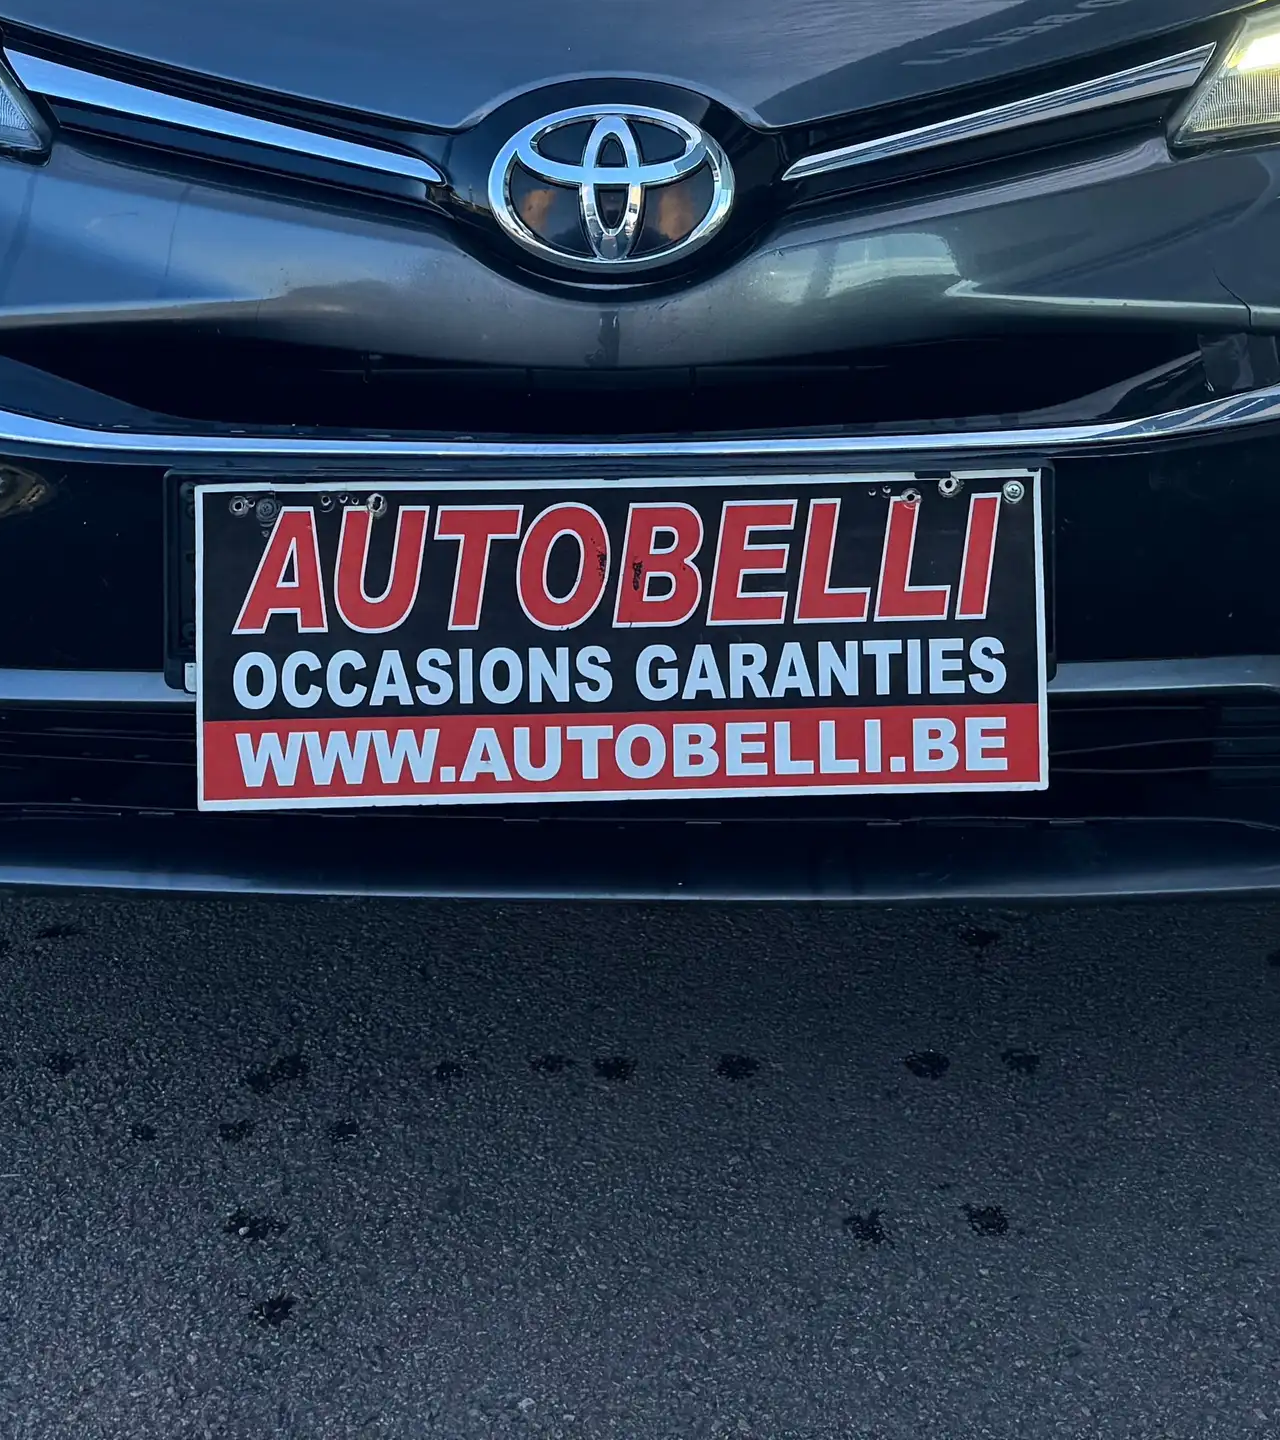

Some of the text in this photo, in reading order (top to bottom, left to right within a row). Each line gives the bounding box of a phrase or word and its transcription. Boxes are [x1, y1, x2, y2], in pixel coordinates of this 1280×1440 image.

[231, 492, 1002, 635] AUTOBELLI
[232, 636, 1007, 710] OCCASIONS GARANTIES
[234, 717, 1008, 788] WWW.AUTOBELLI.BE
